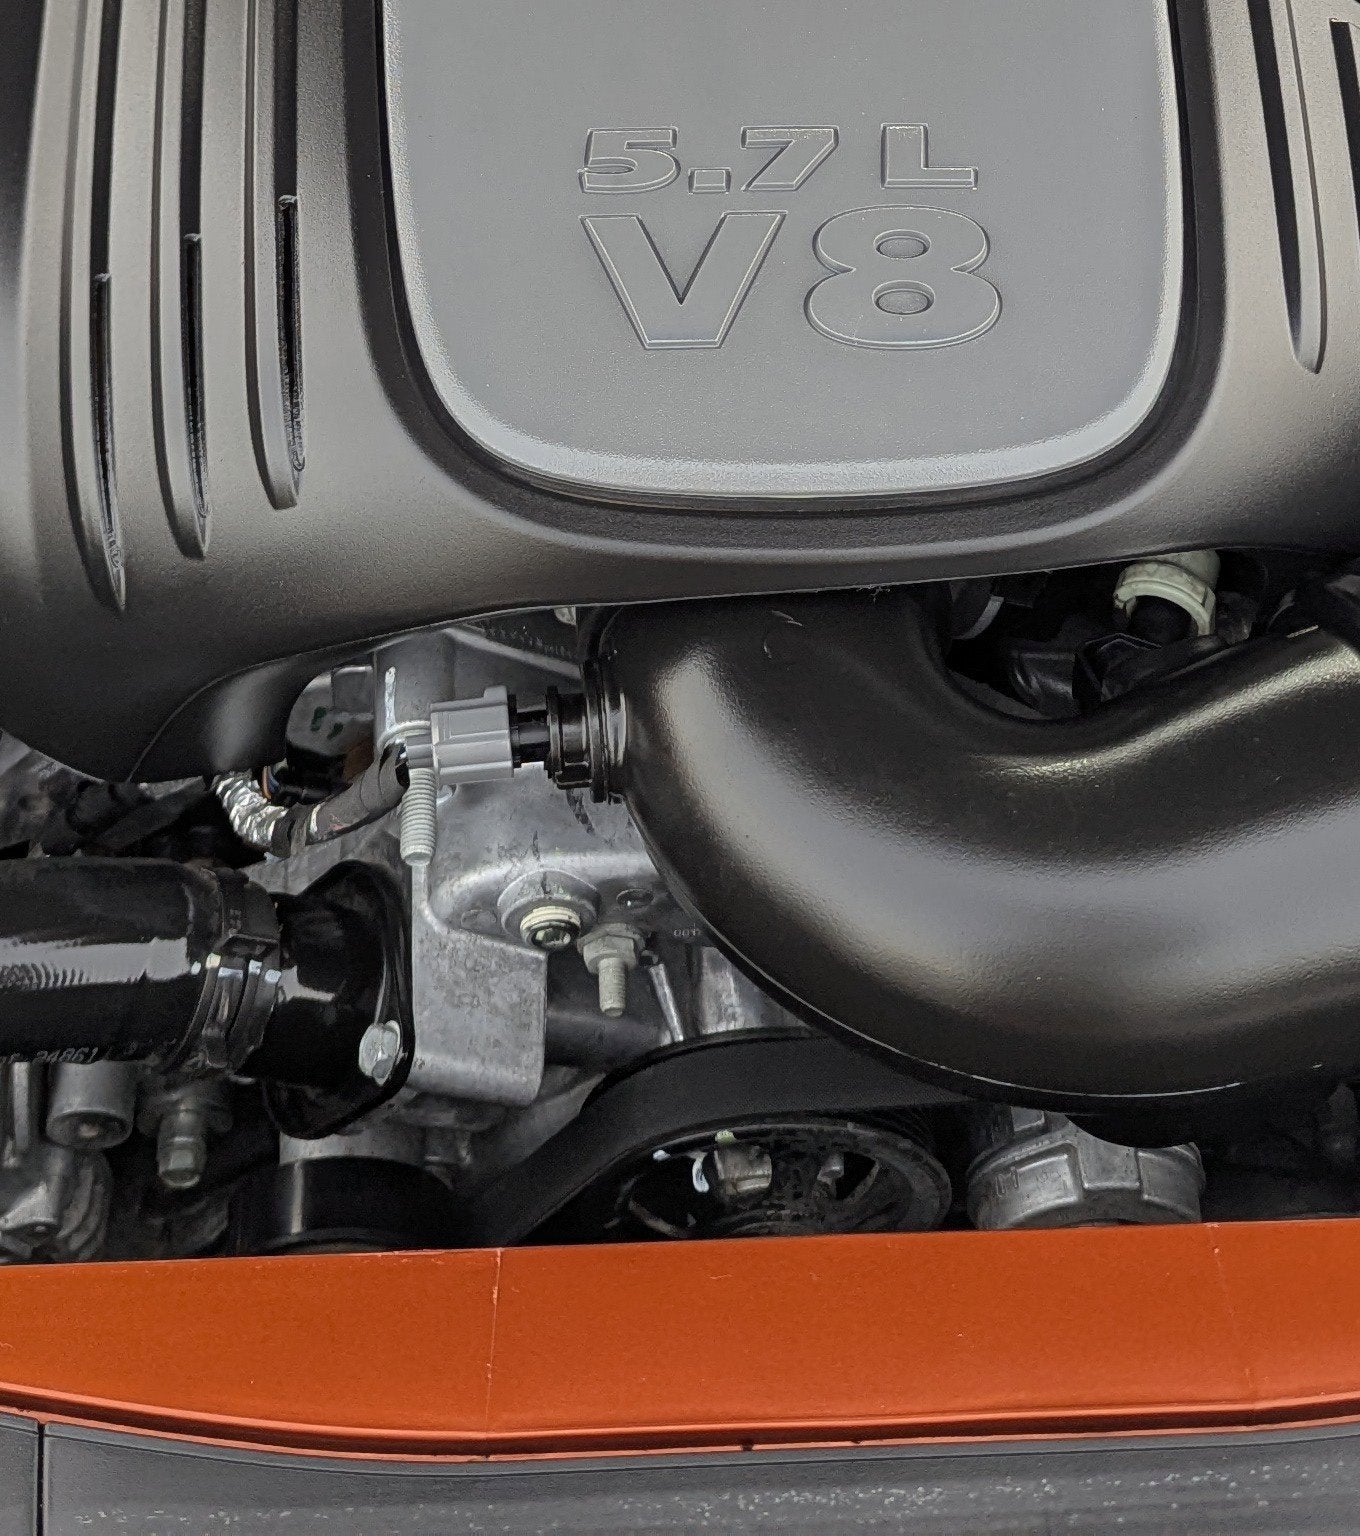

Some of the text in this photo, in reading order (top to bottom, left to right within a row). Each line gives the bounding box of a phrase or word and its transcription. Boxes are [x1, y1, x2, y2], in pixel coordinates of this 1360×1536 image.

[578, 122, 980, 195] 5.7 L
[579, 204, 1003, 351] V8
